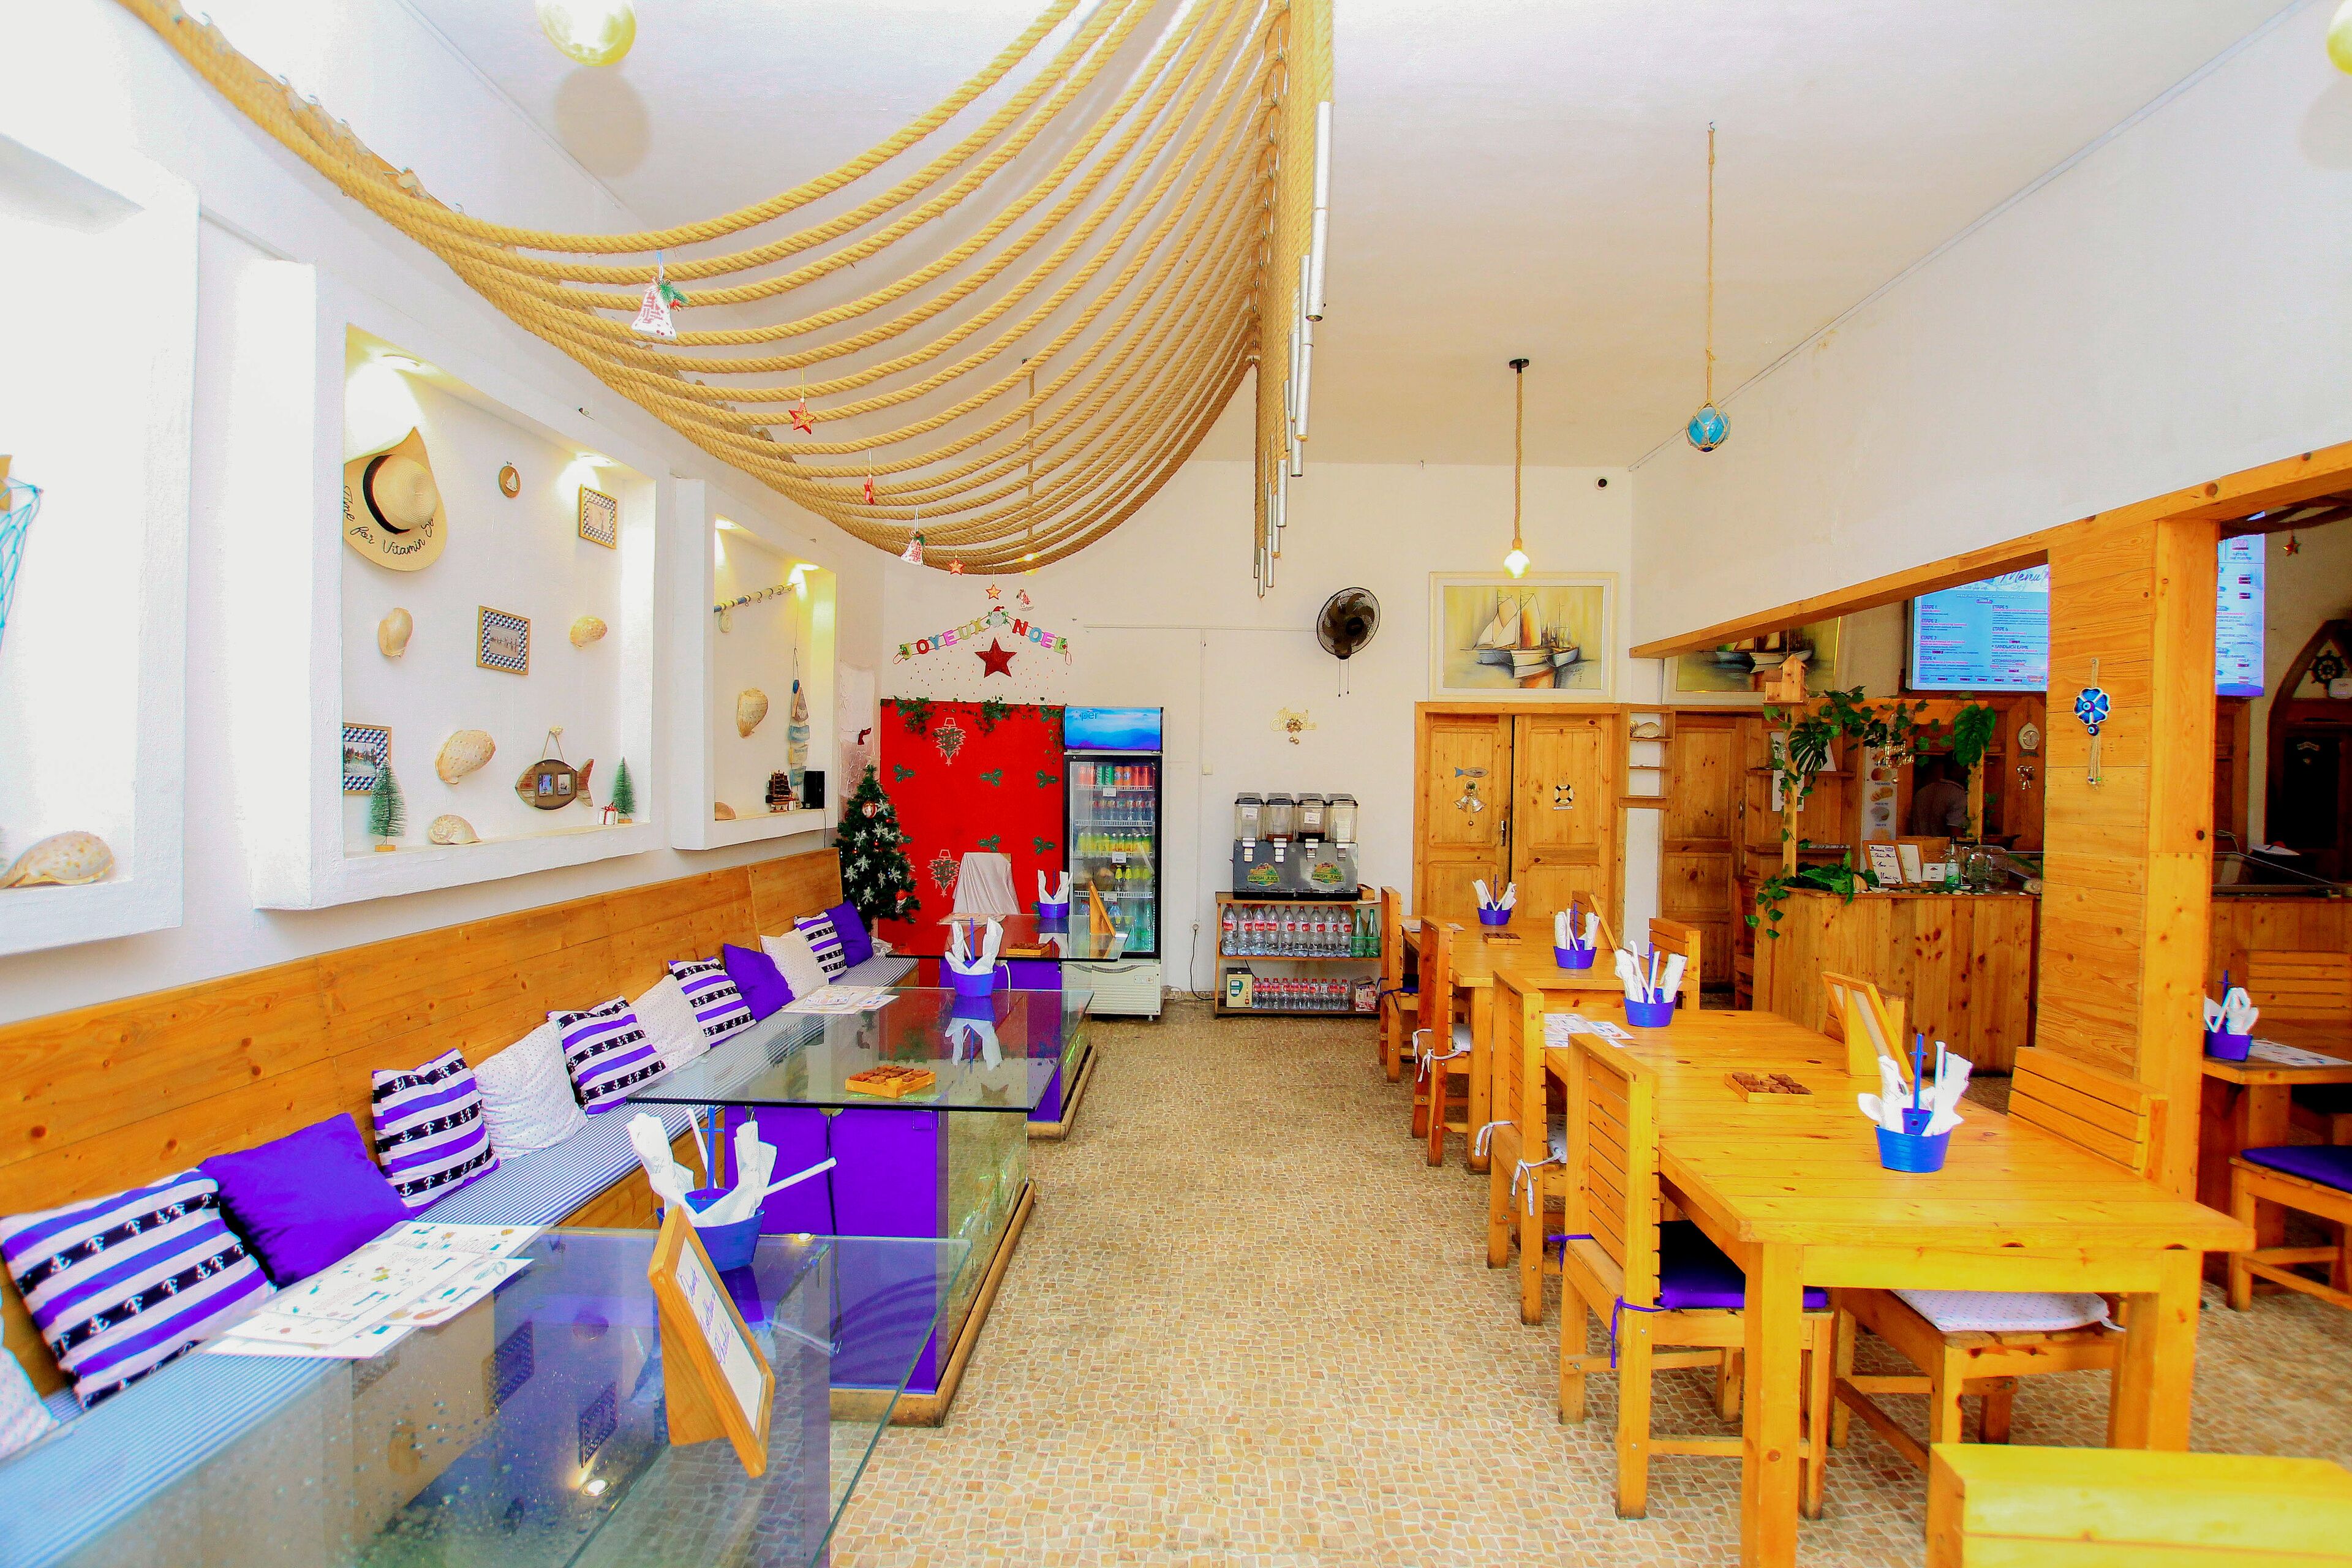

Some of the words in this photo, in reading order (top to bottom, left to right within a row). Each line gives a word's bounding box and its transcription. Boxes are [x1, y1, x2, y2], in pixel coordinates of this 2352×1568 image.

[350, 526, 375, 544] for
[383, 538, 426, 556] Vitamin
[2000, 571, 2041, 582] Menu
[899, 617, 986, 660] JOYEUX
[1012, 618, 1067, 654] NOEL
